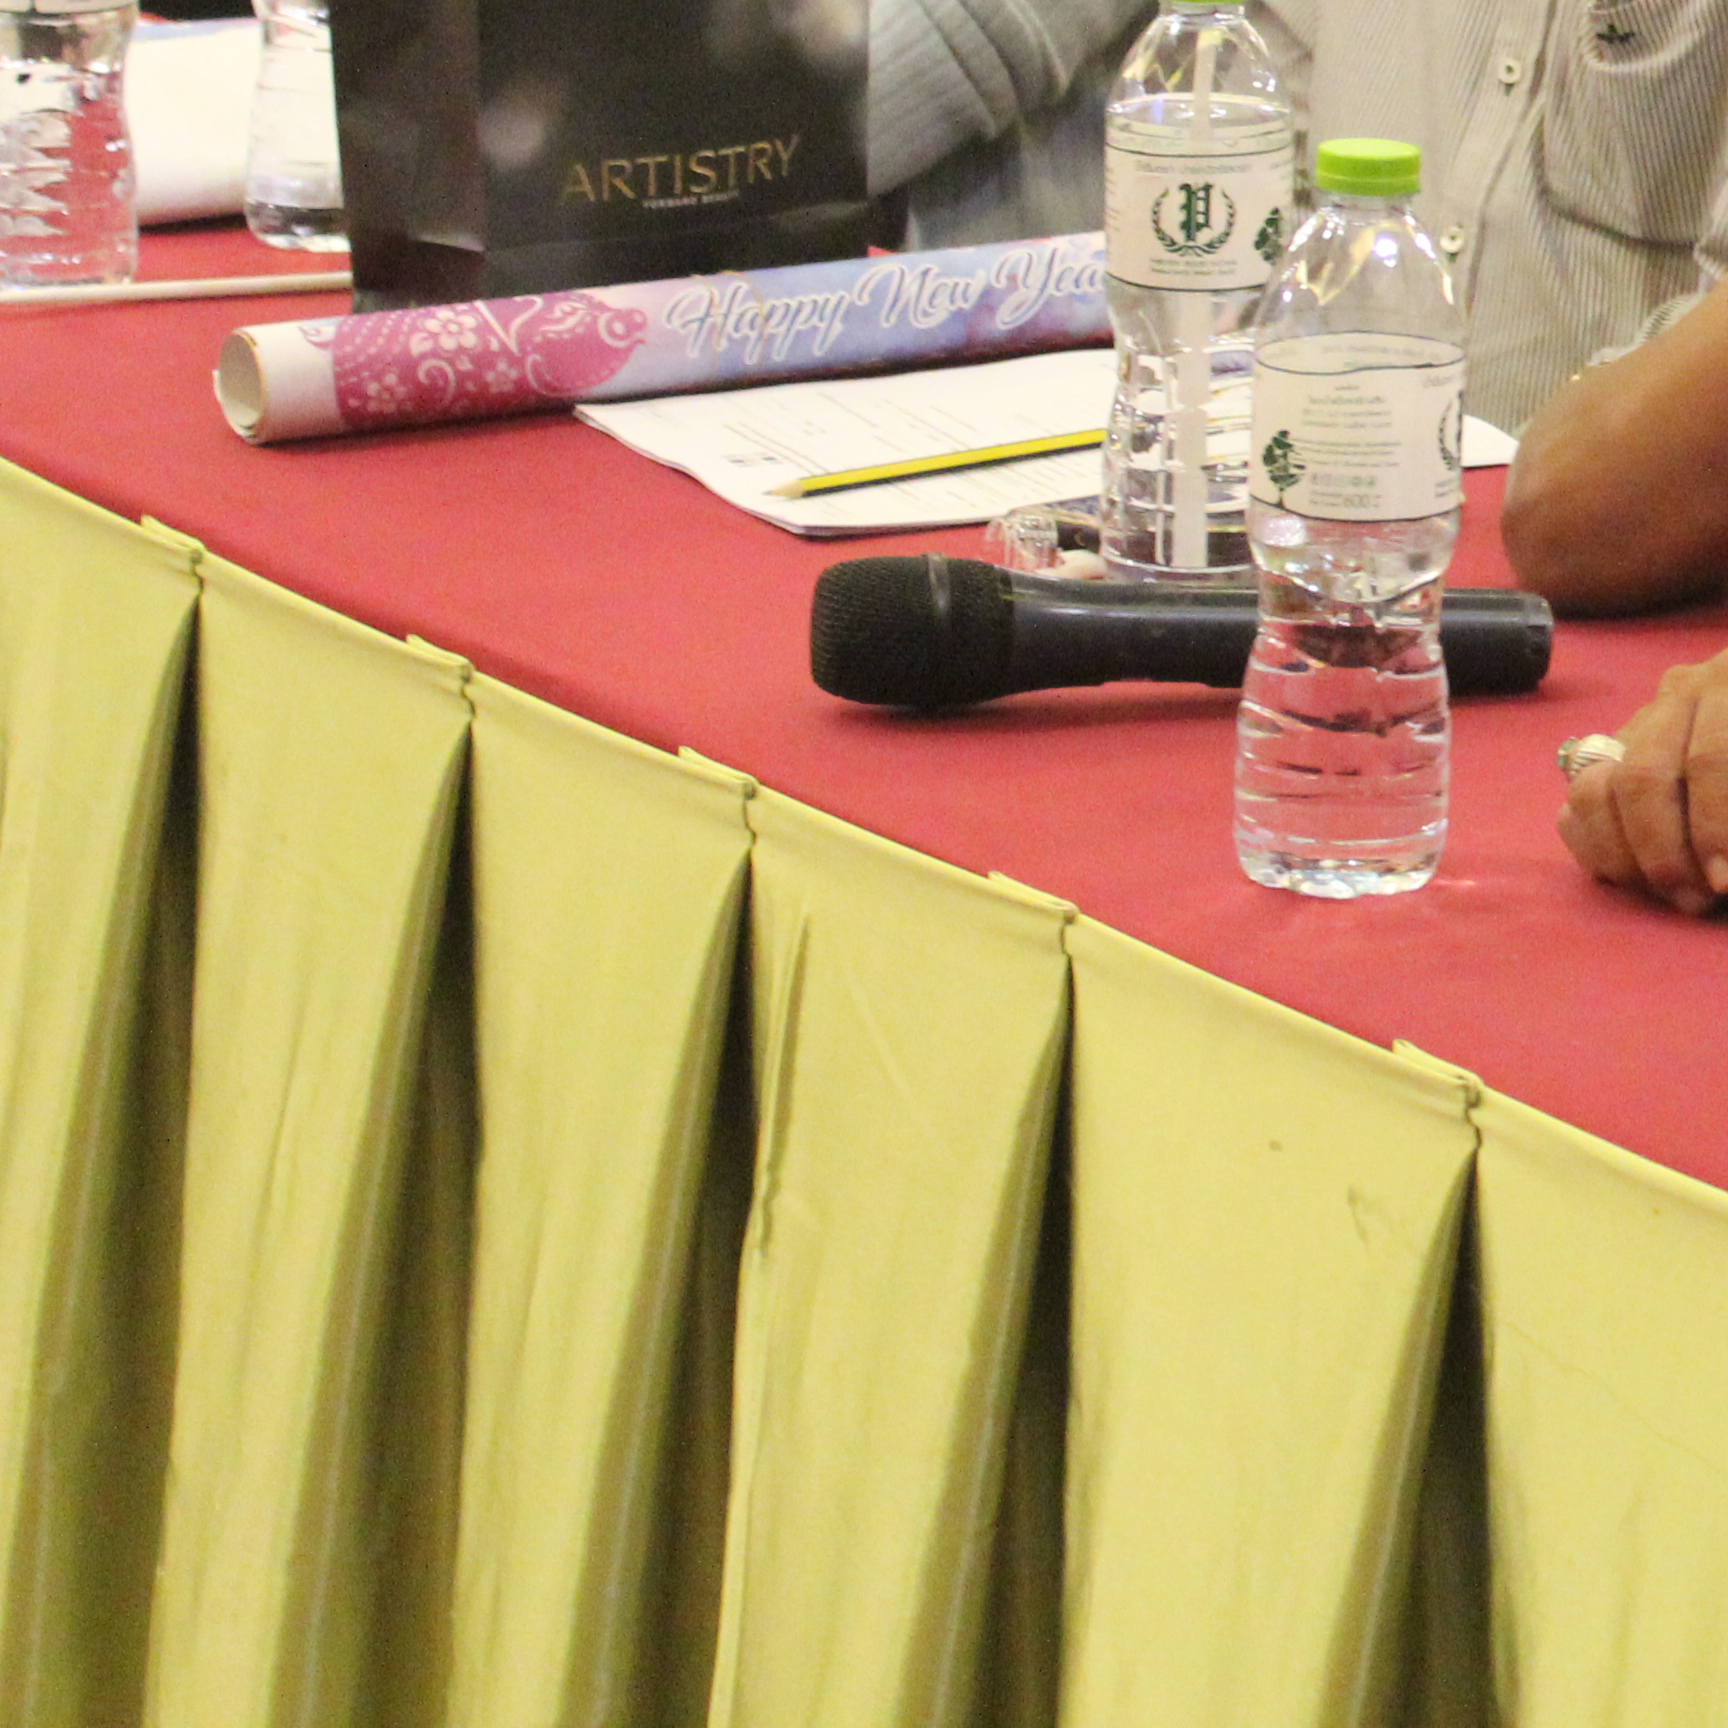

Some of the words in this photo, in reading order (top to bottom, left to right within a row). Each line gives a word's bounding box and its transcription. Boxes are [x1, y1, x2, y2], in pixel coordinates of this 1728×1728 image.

[560, 133, 799, 203] ARTISTRY
[662, 281, 852, 366] Happy
[853, 262, 986, 330] New
[989, 244, 1107, 330] Yea
